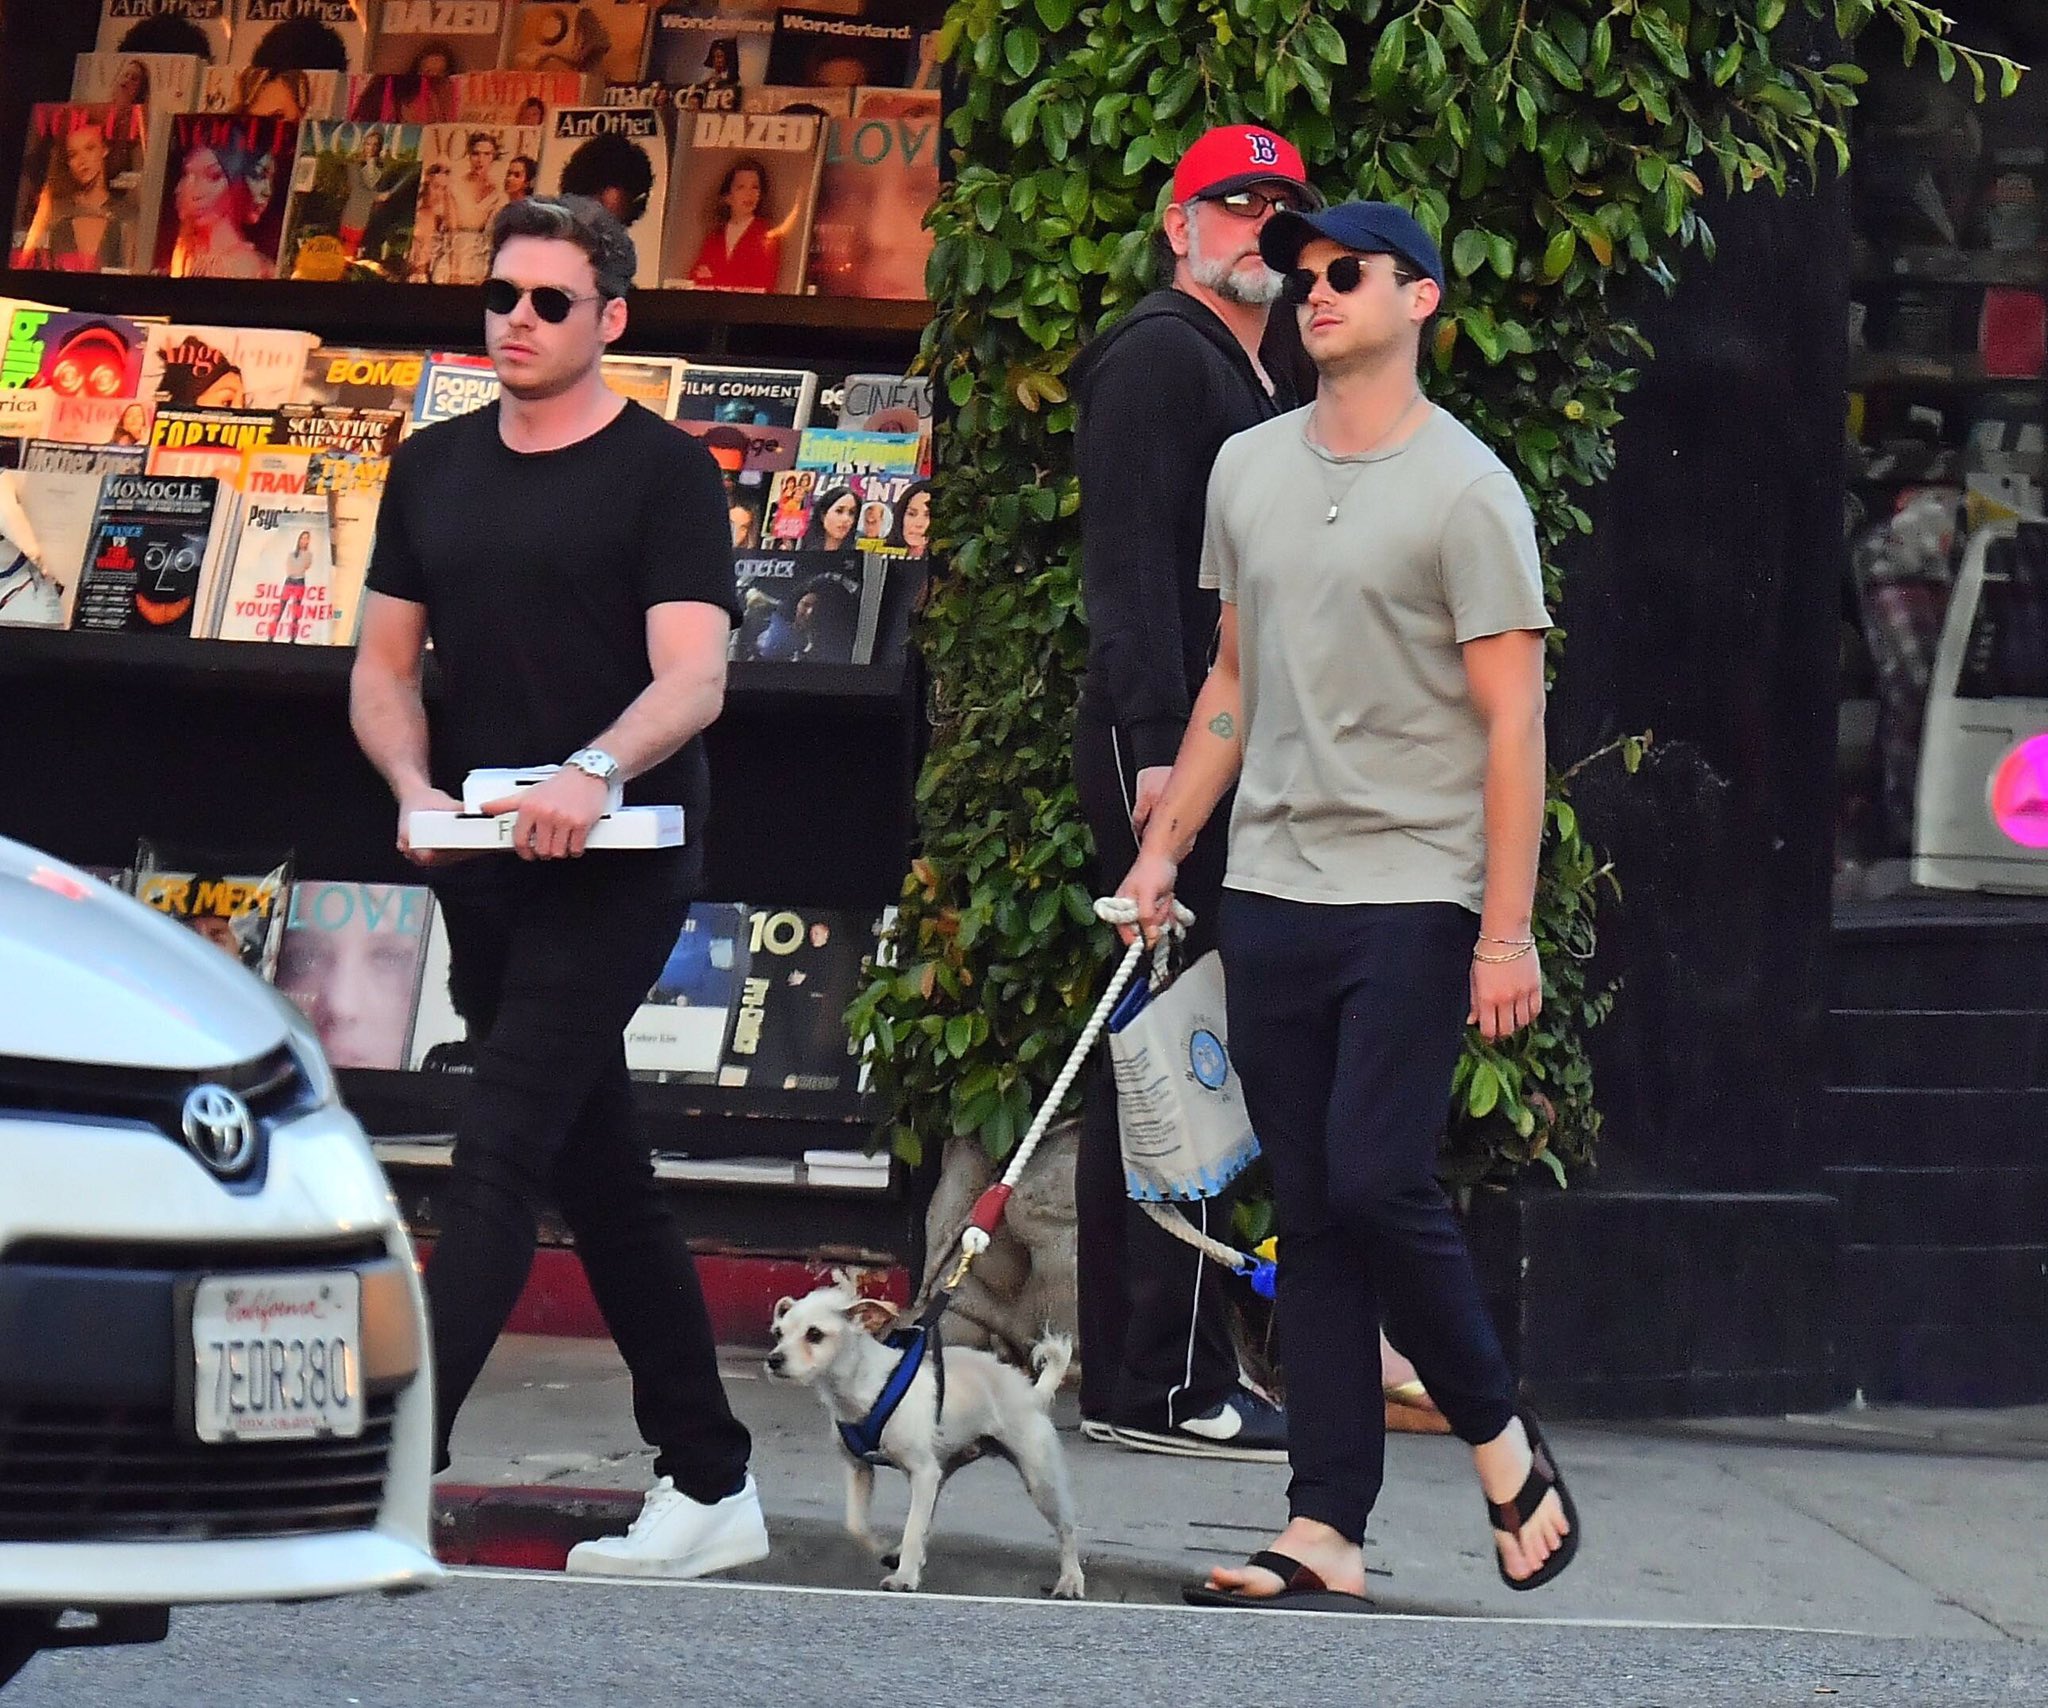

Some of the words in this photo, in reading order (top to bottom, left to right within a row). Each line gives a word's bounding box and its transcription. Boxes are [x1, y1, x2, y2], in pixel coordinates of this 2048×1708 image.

[660, 14, 774, 32] Wonderlan
[603, 80, 668, 106] mari
[559, 112, 652, 135] AnOther
[692, 112, 818, 150] DAZED
[1245, 133, 1279, 165] B
[326, 358, 424, 387] BOMB
[680, 380, 714, 396] FILM
[718, 382, 802, 399] COMMENT
[150, 420, 272, 449] FORTUNE
[287, 418, 390, 438] SCIENTIFIC
[106, 480, 202, 499] MONOCLE
[287, 884, 424, 932] LOVE
[749, 911, 804, 955] 10
